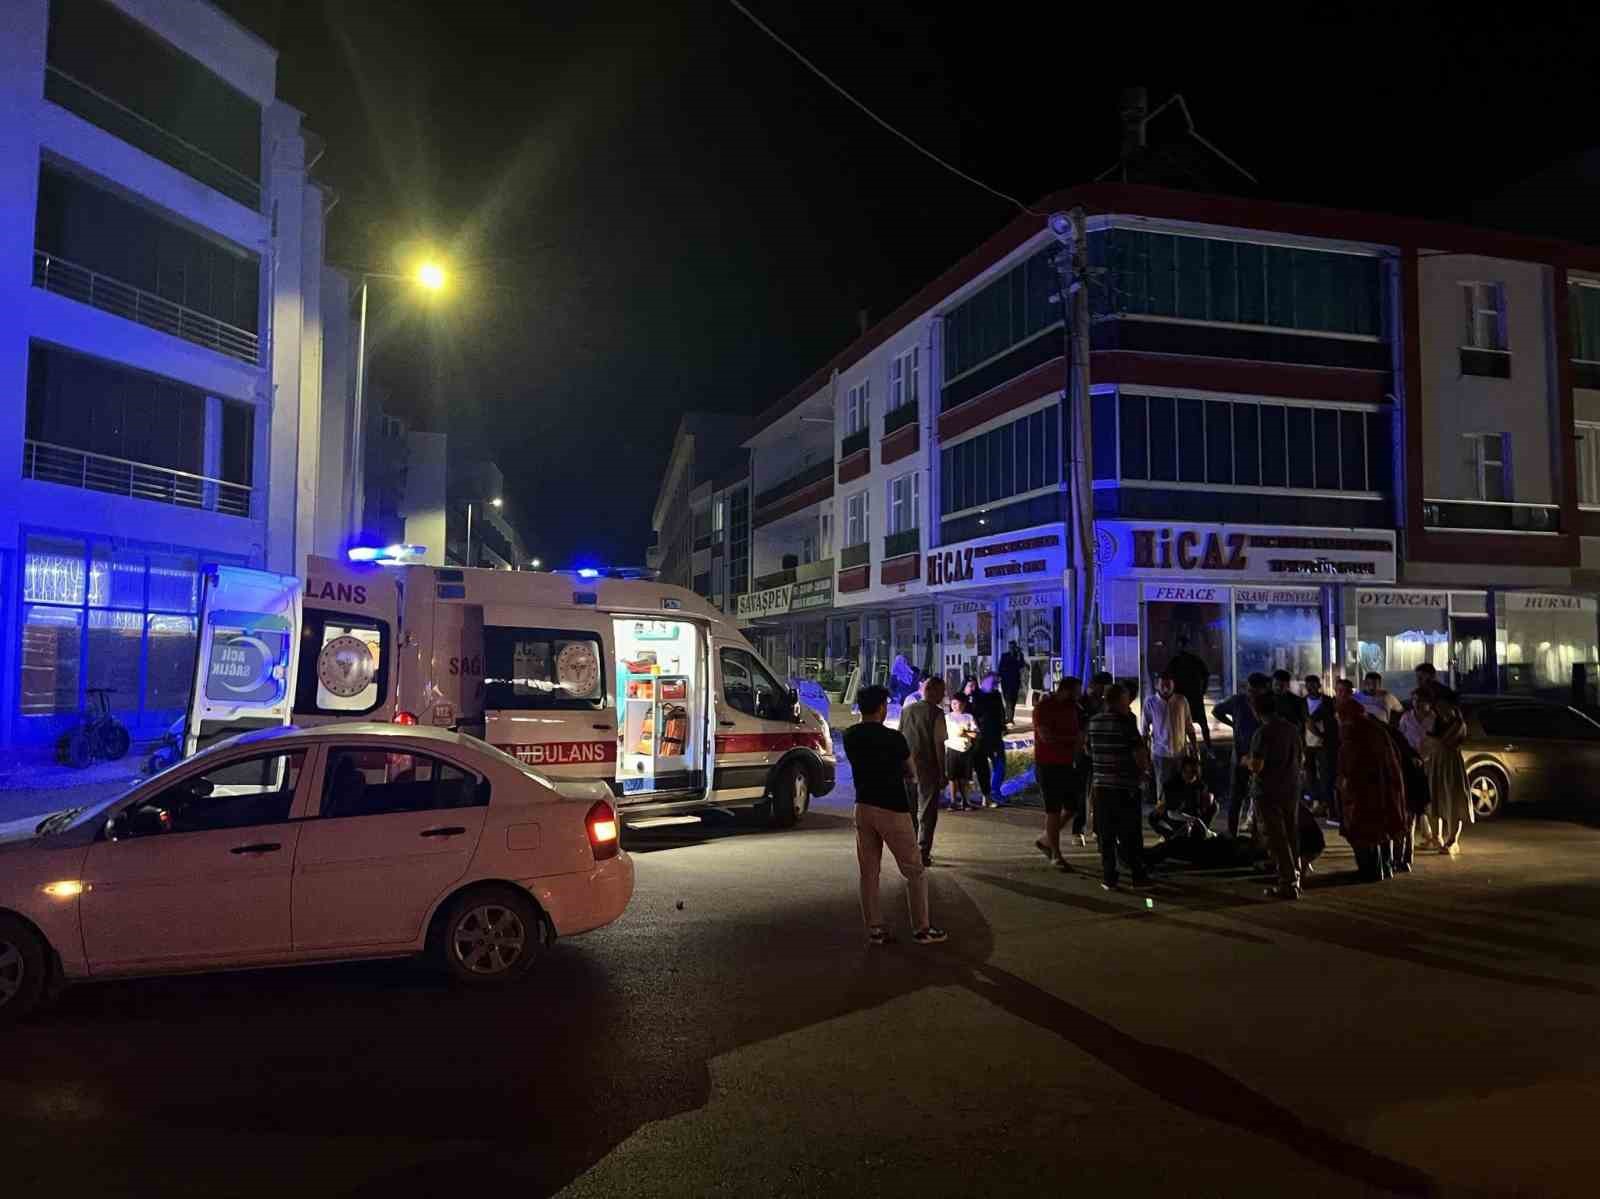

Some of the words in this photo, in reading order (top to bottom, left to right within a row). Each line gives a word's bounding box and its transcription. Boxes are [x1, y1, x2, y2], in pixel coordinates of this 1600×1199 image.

[1156, 588, 1217, 600] FERACE
[1360, 592, 1442, 606] OYUNCAK
[1523, 597, 1579, 609] HURMA
